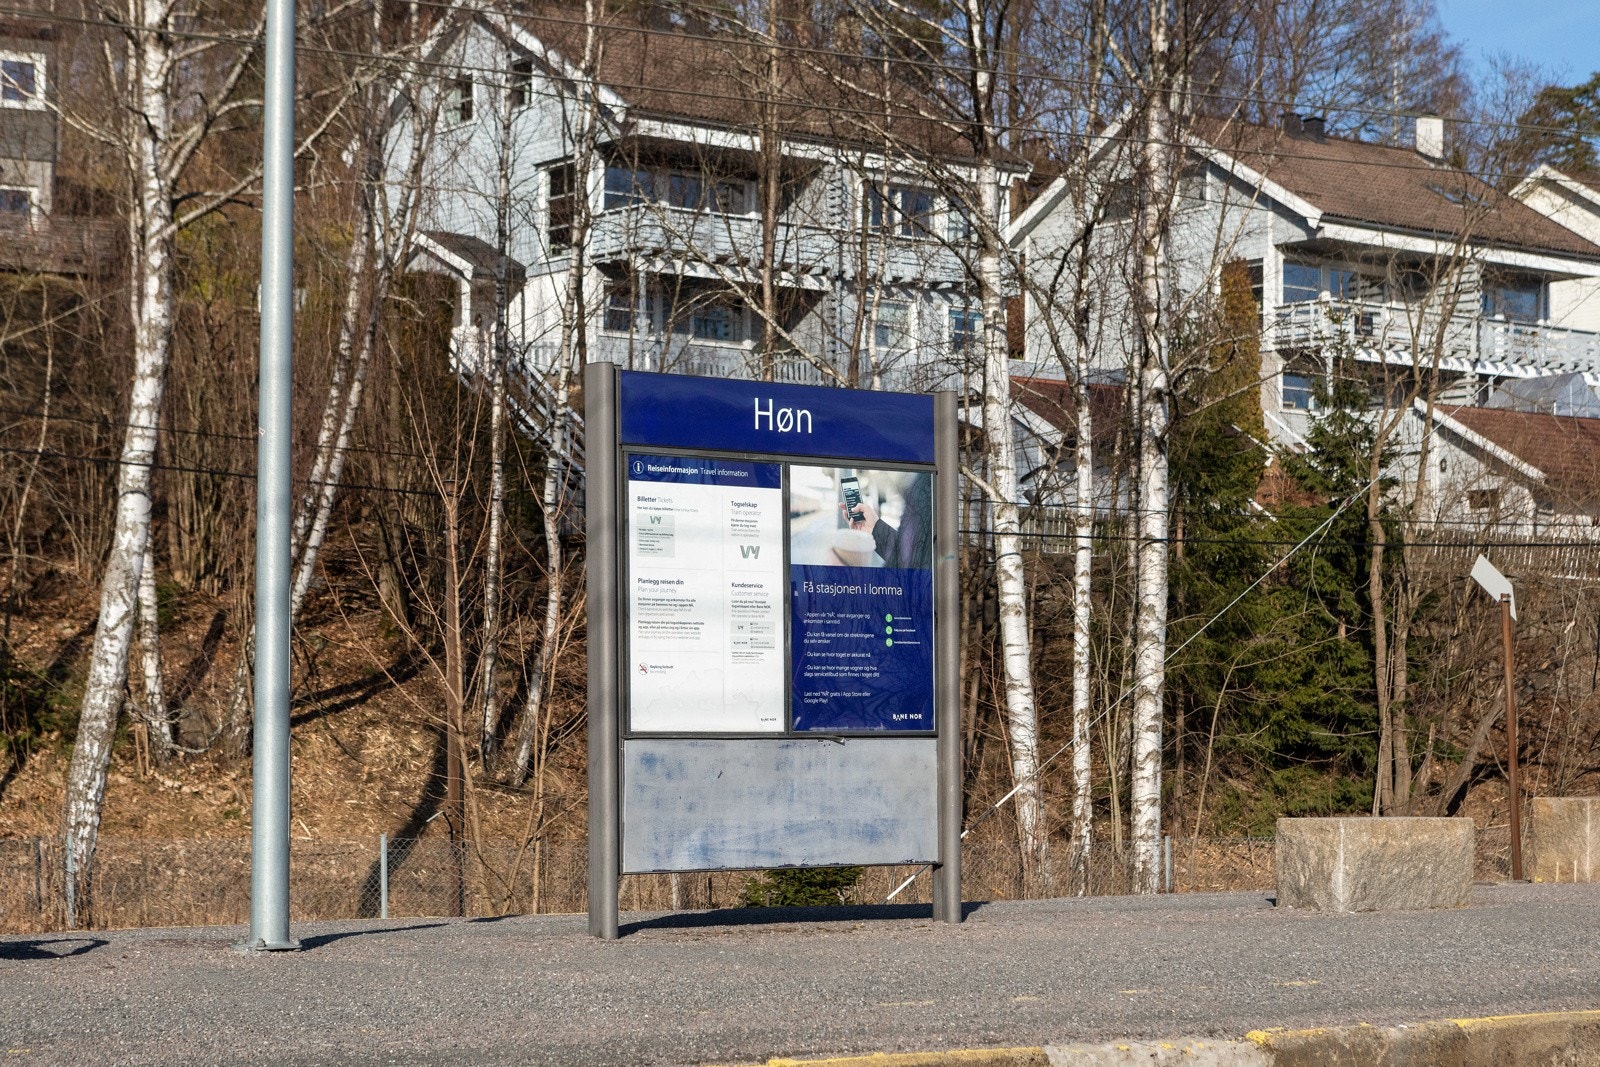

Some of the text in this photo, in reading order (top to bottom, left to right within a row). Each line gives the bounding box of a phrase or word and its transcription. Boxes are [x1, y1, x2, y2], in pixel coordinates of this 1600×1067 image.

[754, 398, 812, 434] Høn
[648, 464, 698, 475] Reiseinformasjon
[717, 468, 748, 477] information
[803, 581, 903, 596] Få stasjonen i lomma
